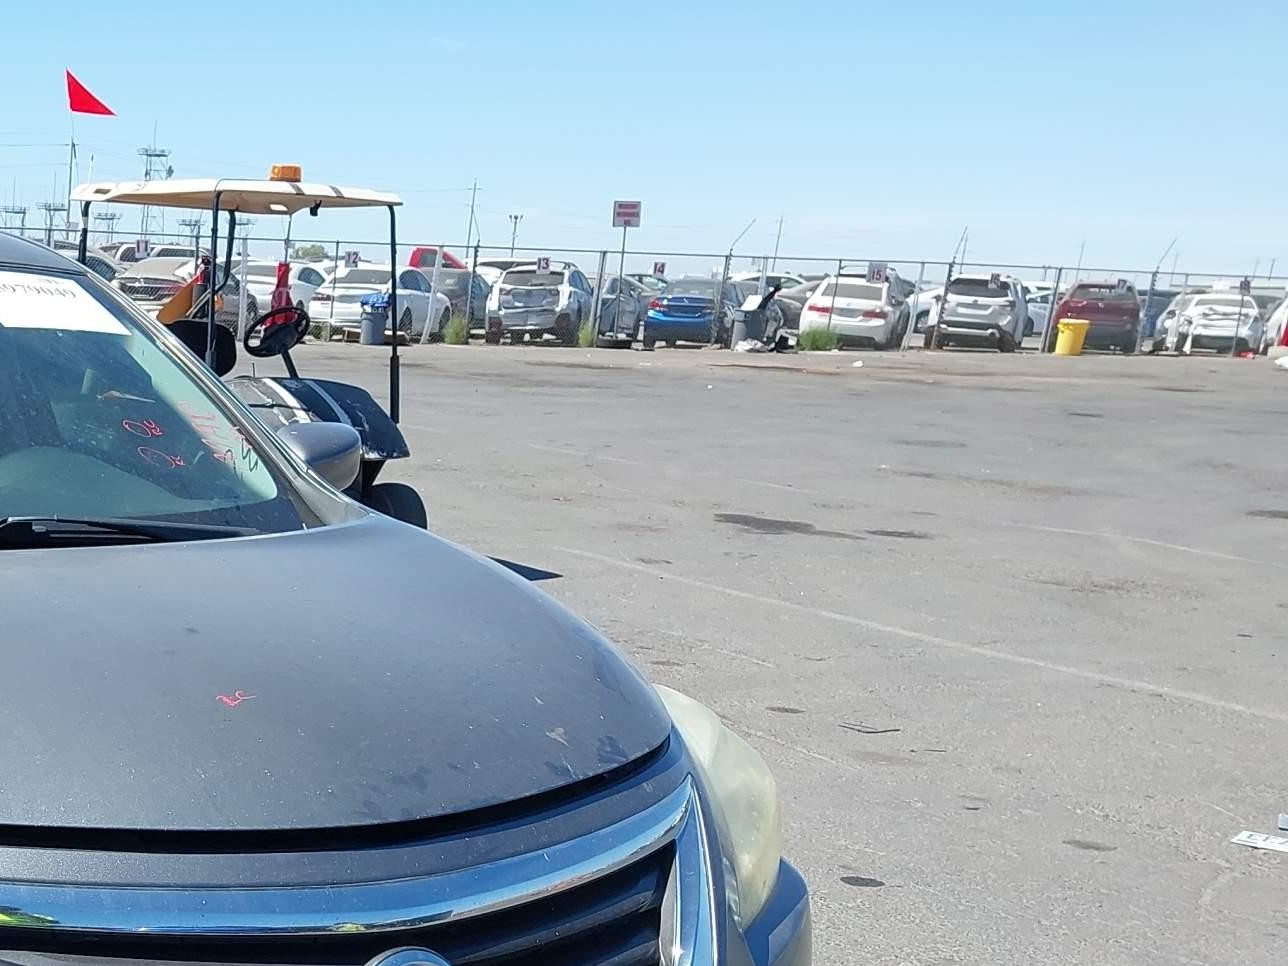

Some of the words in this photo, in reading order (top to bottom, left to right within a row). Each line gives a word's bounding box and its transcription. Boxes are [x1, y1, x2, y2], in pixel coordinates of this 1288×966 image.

[345, 251, 359, 265] 12
[537, 257, 550, 270] 13
[654, 261, 665, 275] 14
